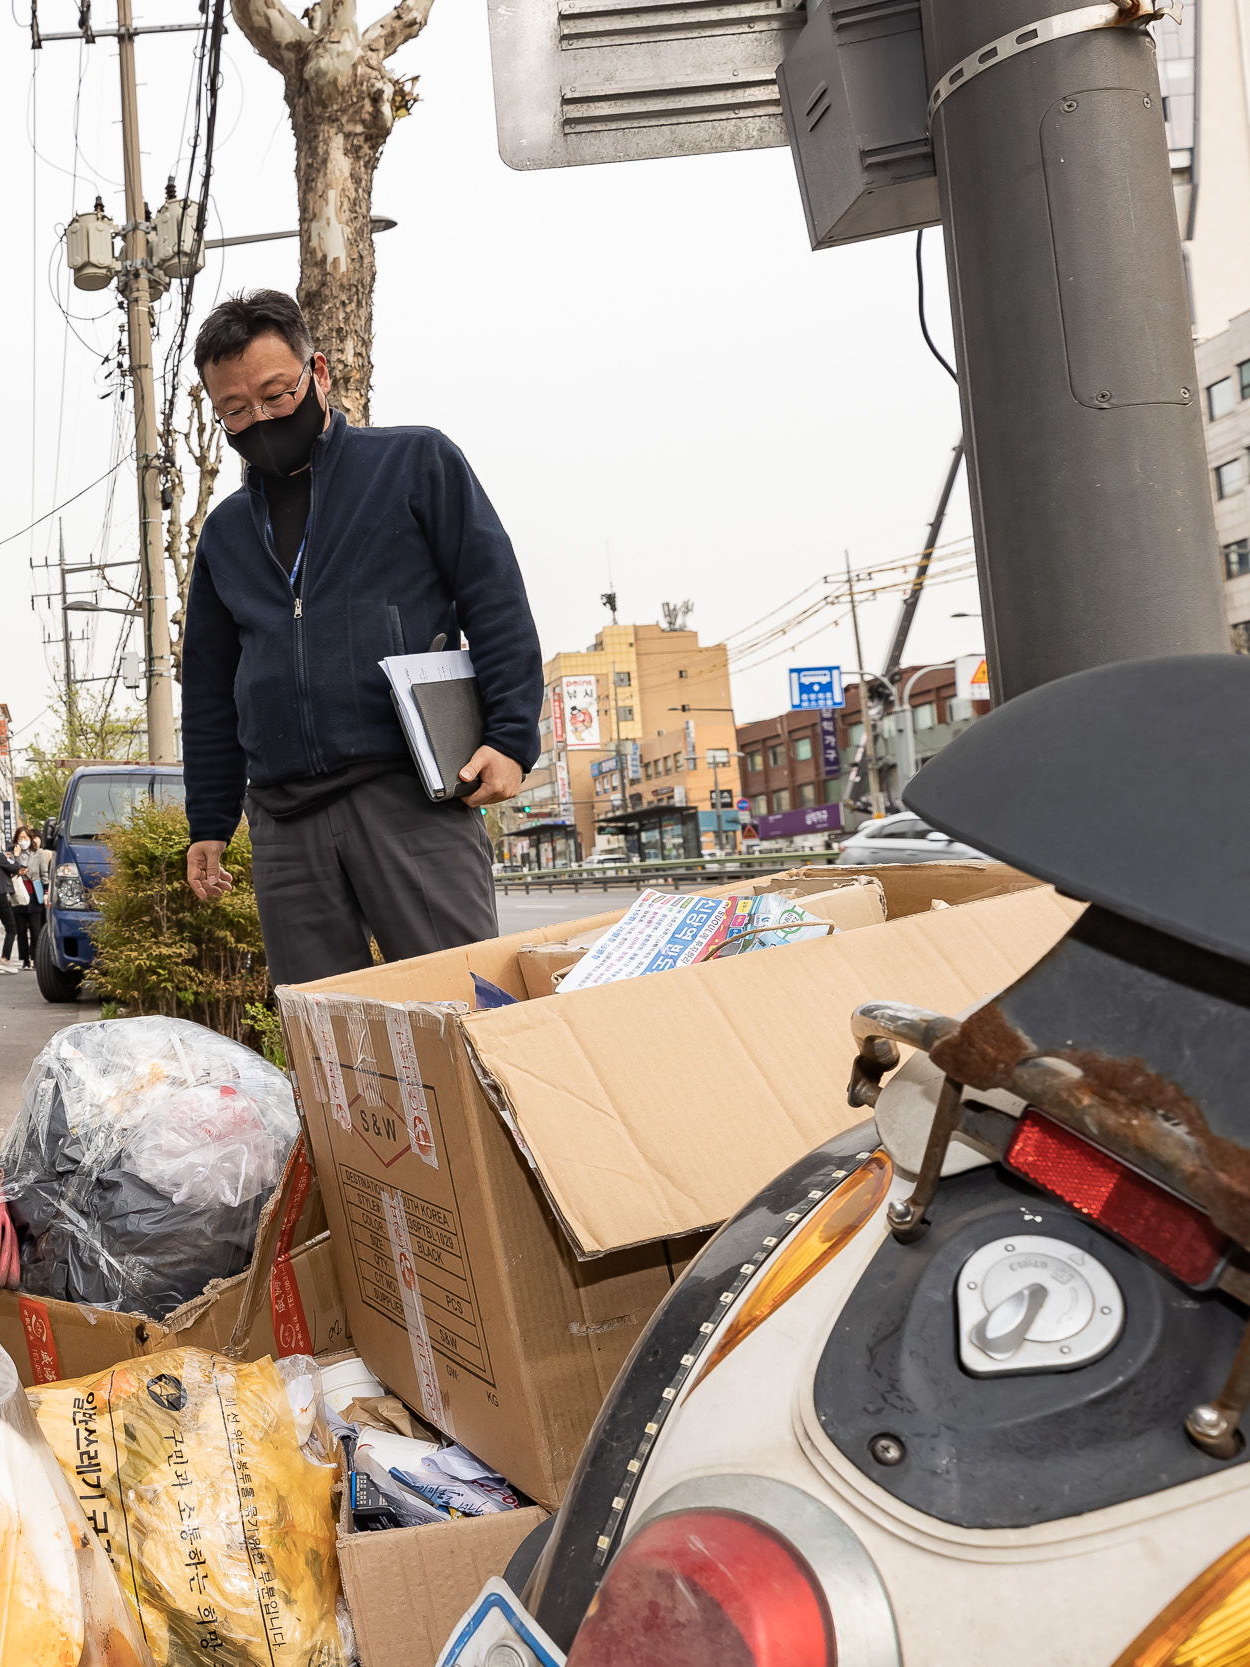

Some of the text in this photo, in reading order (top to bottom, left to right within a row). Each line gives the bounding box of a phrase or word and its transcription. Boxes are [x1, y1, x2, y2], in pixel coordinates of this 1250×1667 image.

[675, 899, 717, 941] 신당역
[400, 1193, 419, 1214] OUTH
[420, 1204, 449, 1227] KOREA
[417, 1241, 444, 1265] BLACK
[446, 1295, 463, 1314] PCS
[439, 1329, 457, 1350] S&W
[446, 1365, 460, 1382] GW:
[486, 1390, 499, 1407] KG
[230, 1410, 240, 1424] 선
[71, 1391, 105, 1501] 일반쓰레기
[231, 1428, 245, 1457] 위는
[235, 1458, 256, 1499] 봉투를
[163, 1428, 225, 1652] 구민과 소통하는 희망
[257, 1570, 288, 1653] 부분입니다.
